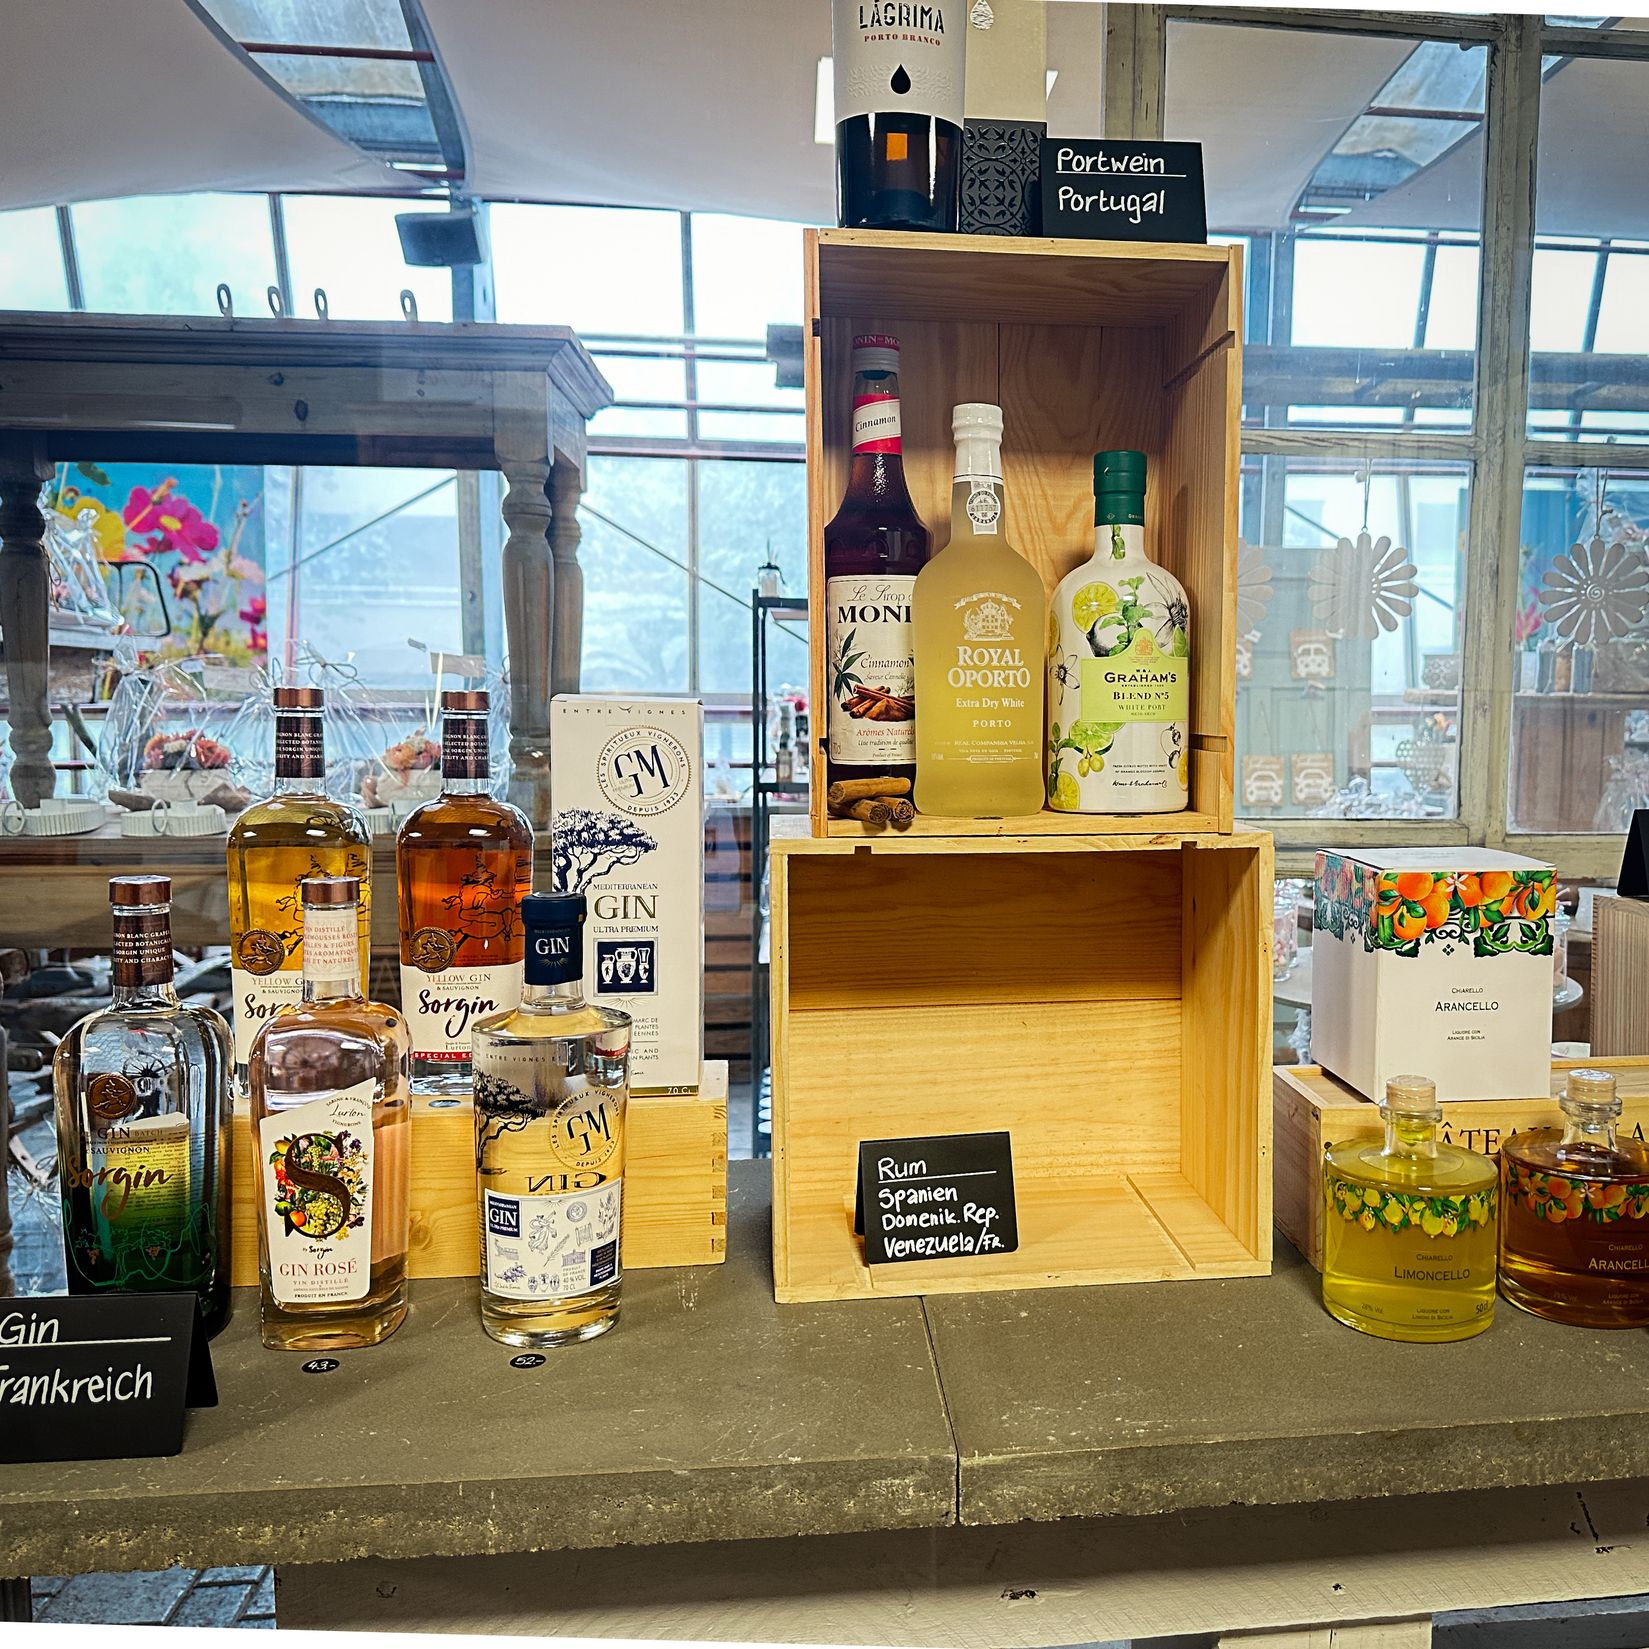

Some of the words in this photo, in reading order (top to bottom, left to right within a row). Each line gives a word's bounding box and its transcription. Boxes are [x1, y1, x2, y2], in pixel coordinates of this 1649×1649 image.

[864, 33, 898, 42] PORTO
[902, 33, 941, 46] BRANCO
[1056, 147, 1165, 174] Portwein
[1058, 186, 1165, 224] Portugal
[855, 415, 896, 432] Cinnamon
[860, 654, 909, 669] Cinnamon
[957, 645, 1024, 667] ROYAL
[947, 667, 1031, 688] OPORTO
[1104, 672, 1177, 683] GRAHAM'S
[956, 697, 979, 708] Extra
[982, 697, 998, 709] Dry
[1002, 697, 1025, 708] White
[1114, 691, 1152, 700] BLEND
[972, 719, 1012, 728] PORTO
[600, 730, 641, 767] SPIRITUEUX
[648, 730, 686, 768] VIGNERONS
[593, 883, 658, 891] MEDITERRANEAN
[594, 894, 659, 920] GIN
[620, 925, 659, 933] PREMIUM
[535, 936, 570, 955] GIN
[252, 977, 292, 985] YELLOW
[426, 974, 466, 982] YELLOW
[469, 973, 491, 981] GIN
[419, 988, 500, 1039] Sorgin
[1435, 1001, 1499, 1012] ARANCELLO
[97, 1126, 131, 1139] GIN
[91, 1146, 150, 1155] SAUVIGNON
[877, 1156, 927, 1181] Rum
[68, 1156, 173, 1220] Sorgin
[878, 1186, 958, 1213] Spanien
[489, 1208, 518, 1226] GIN
[881, 1208, 961, 1231] Domenik.
[963, 1202, 1000, 1228] Rep.
[1416, 1253, 1453, 1262] CHIARELLO
[1588, 1257, 1649, 1271] ARANCELL
[279, 1262, 308, 1276] GIN
[313, 1257, 357, 1276] ROSÉ
[1393, 1266, 1471, 1281] LIMONCELLO
[0, 1312, 59, 1345] Gin
[0, 1364, 153, 1406] rankreich
